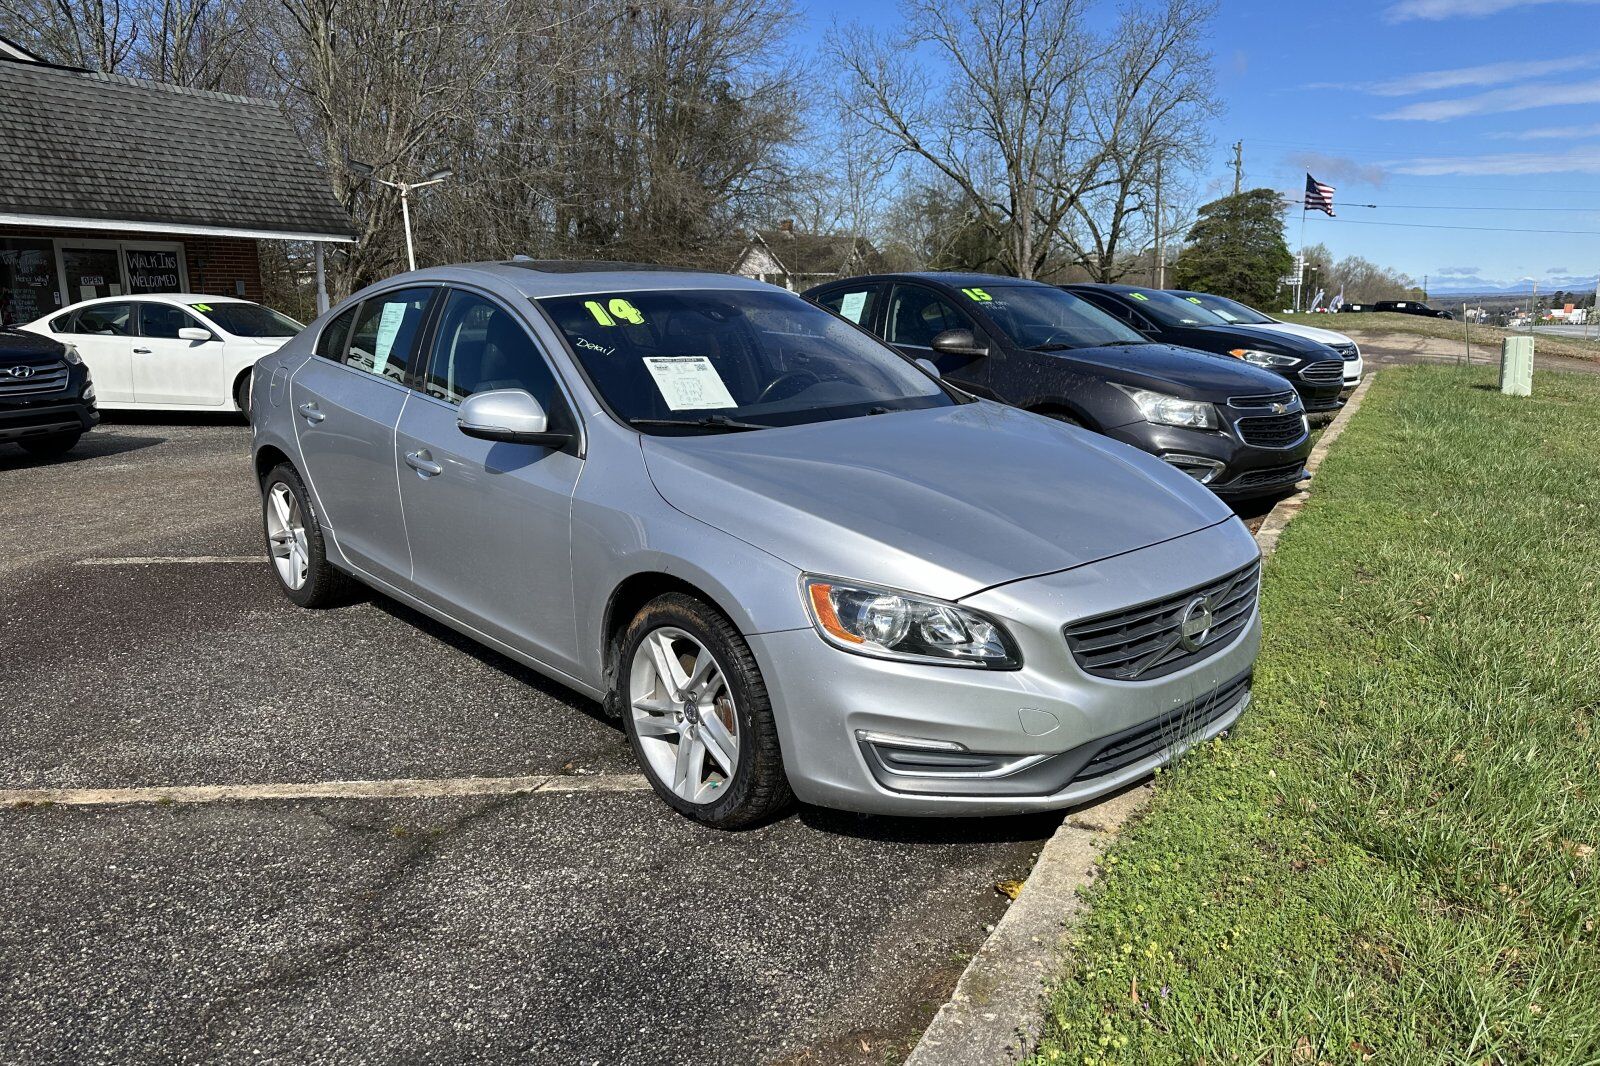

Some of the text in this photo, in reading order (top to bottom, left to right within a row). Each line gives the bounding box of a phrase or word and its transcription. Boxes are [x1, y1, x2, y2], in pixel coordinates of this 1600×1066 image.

[127, 252, 177, 269] WALK INS
[82, 277, 103, 285] OPEN
[128, 271, 177, 287] WELCOMED
[961, 287, 993, 302] 15
[584, 298, 645, 327] 14
[576, 337, 616, 356] Detail
